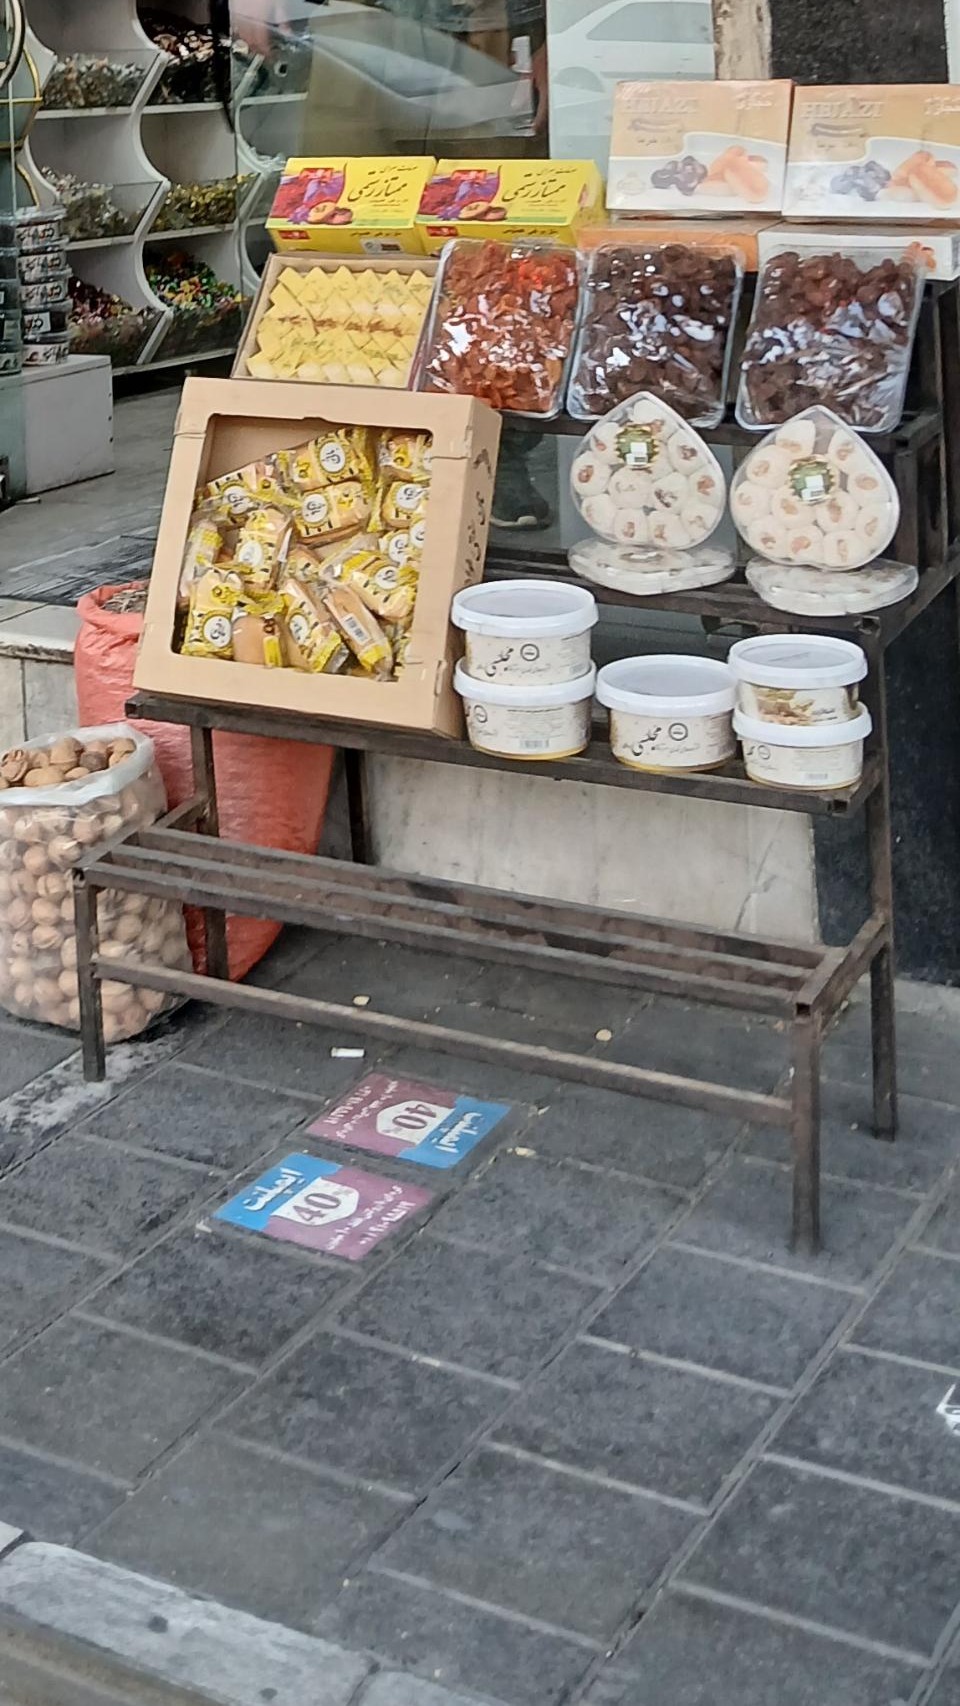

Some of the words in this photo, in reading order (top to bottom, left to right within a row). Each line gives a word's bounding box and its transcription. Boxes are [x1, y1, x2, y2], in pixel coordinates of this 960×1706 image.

[391, 1102, 441, 1131] 40
[242, 1165, 305, 1213] ایمپلنت
[291, 1192, 341, 1224] 40
